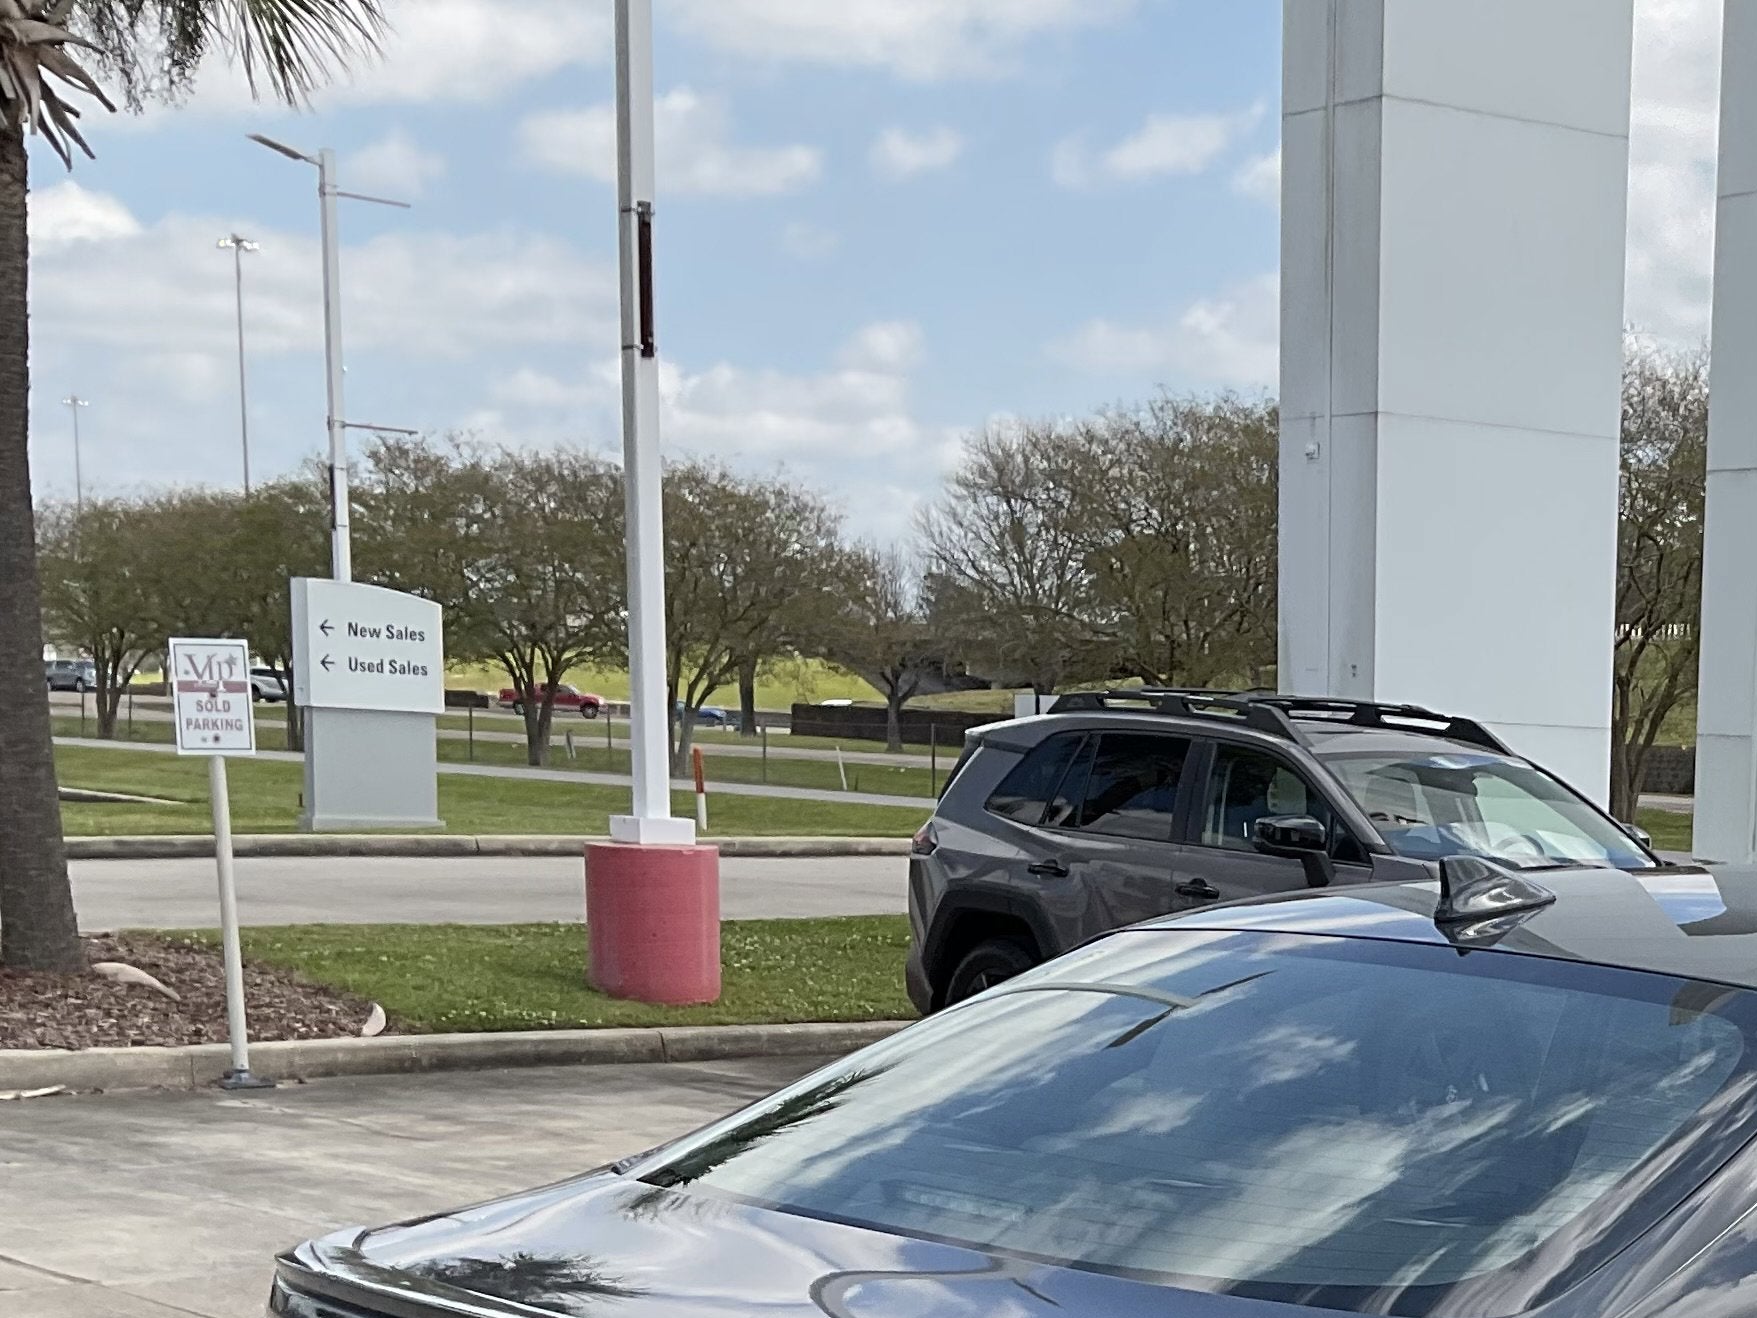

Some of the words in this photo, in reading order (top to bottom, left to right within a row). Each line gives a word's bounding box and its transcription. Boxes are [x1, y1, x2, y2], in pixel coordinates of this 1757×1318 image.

[347, 621, 381, 638] New
[385, 623, 425, 641] Sales
[347, 656, 385, 674] Used
[388, 659, 428, 676] Sales
[195, 699, 231, 713] SOLD
[185, 718, 244, 732] PARKING
